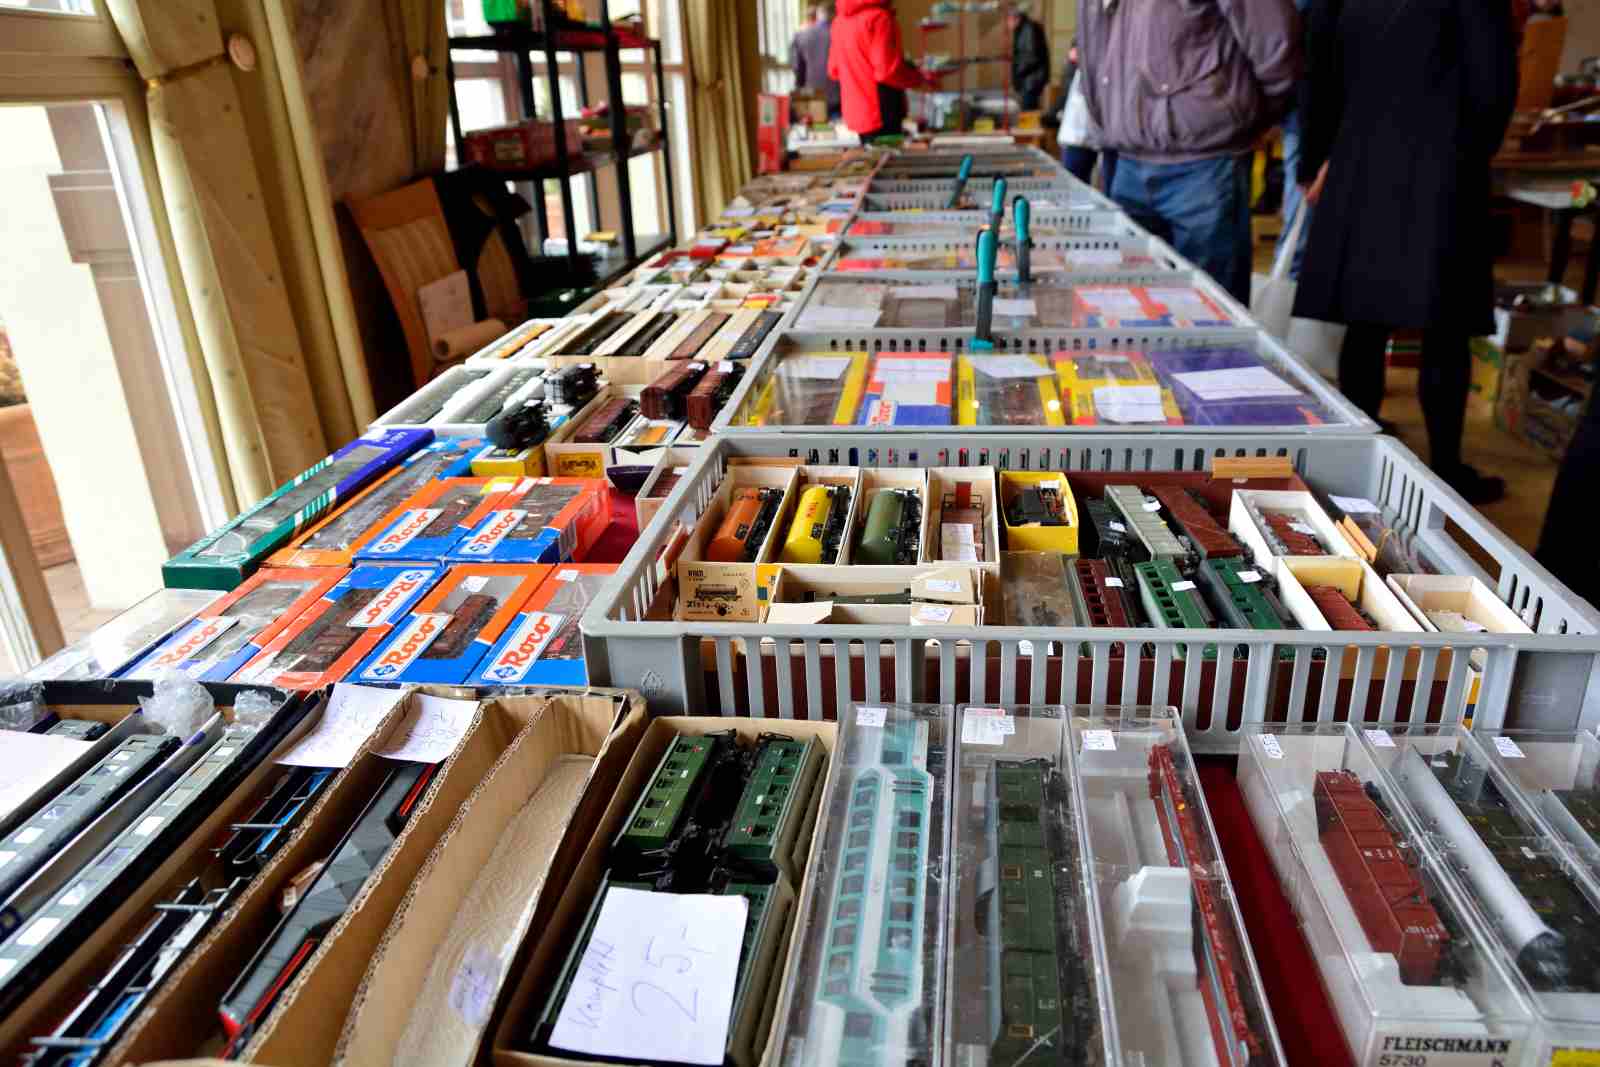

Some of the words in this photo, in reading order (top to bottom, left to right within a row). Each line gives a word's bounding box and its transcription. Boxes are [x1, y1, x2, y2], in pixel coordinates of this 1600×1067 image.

[383, 511, 429, 544] Roco
[473, 511, 516, 544] Roco
[365, 580, 418, 624] Roco
[156, 618, 223, 667] Roco
[380, 616, 436, 667] Roco
[498, 615, 551, 667] Roco
[1379, 1055, 1427, 1067] 5730
[1383, 1036, 1512, 1054] FLEISCHMANN
